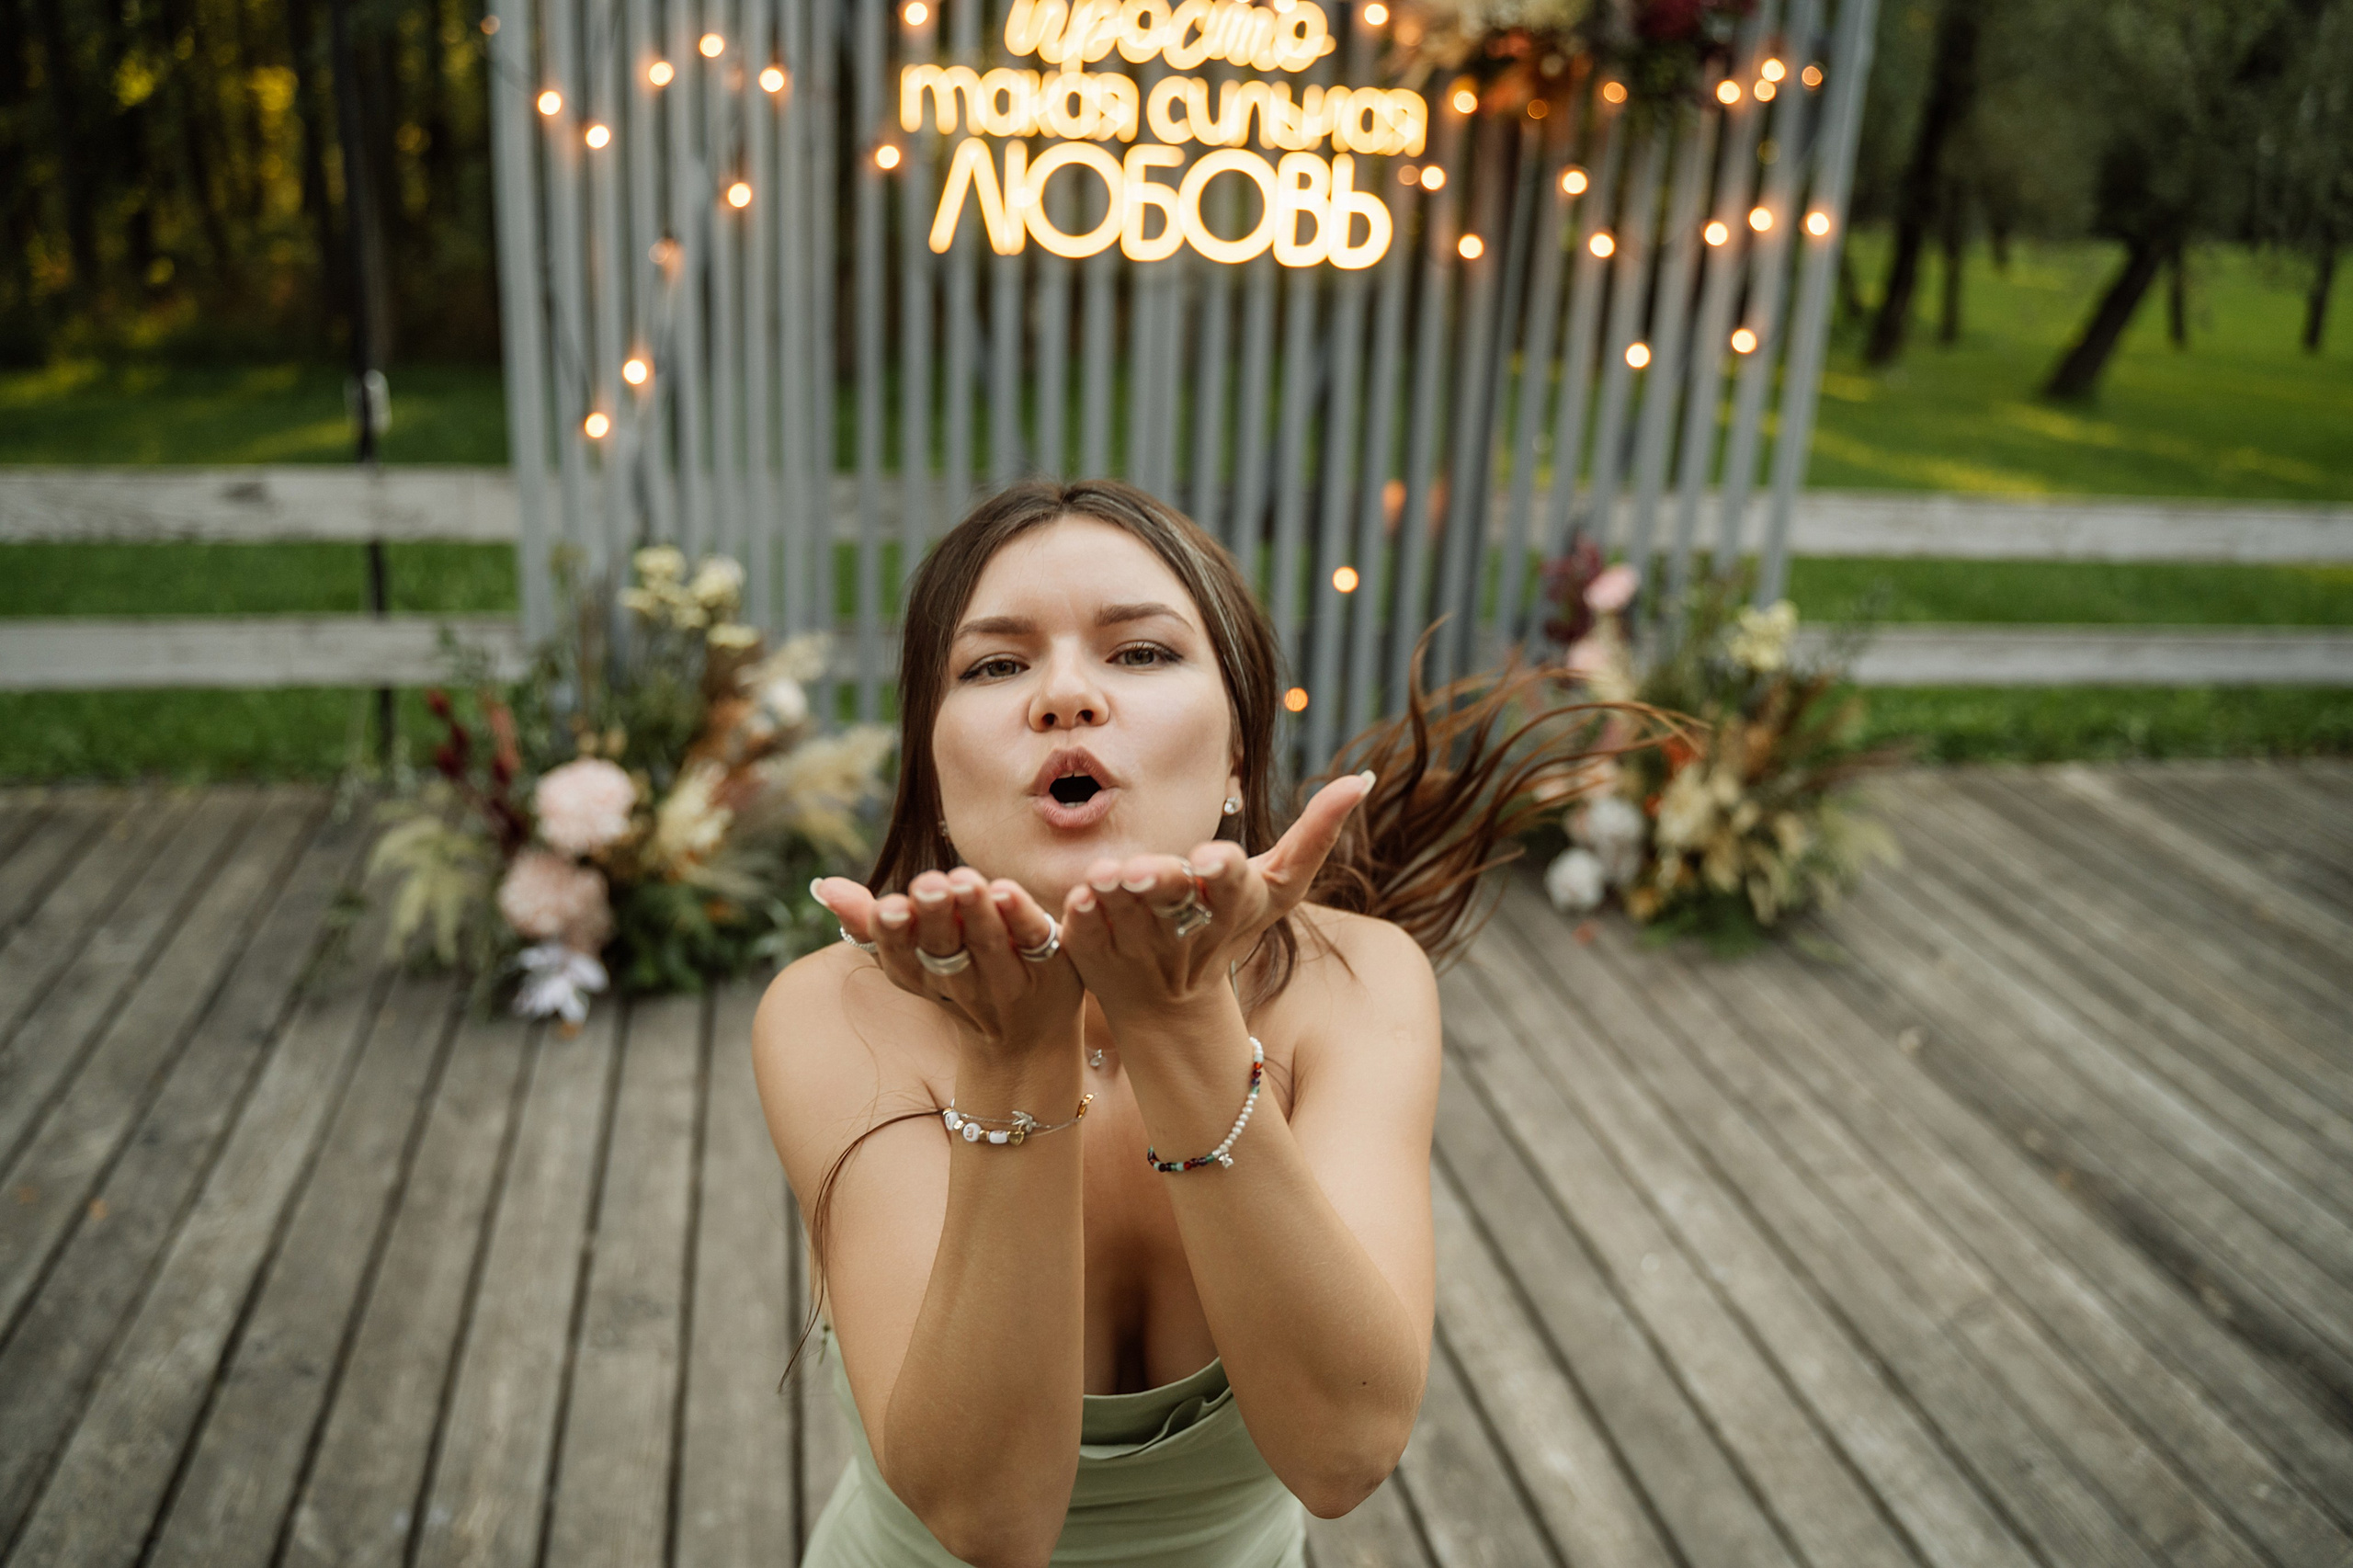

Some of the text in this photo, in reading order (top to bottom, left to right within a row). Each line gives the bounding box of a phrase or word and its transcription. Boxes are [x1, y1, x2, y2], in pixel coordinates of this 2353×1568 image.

[901, 64, 1428, 157] такая сильная
[928, 137, 1393, 269] ЛЮБОВЬ
